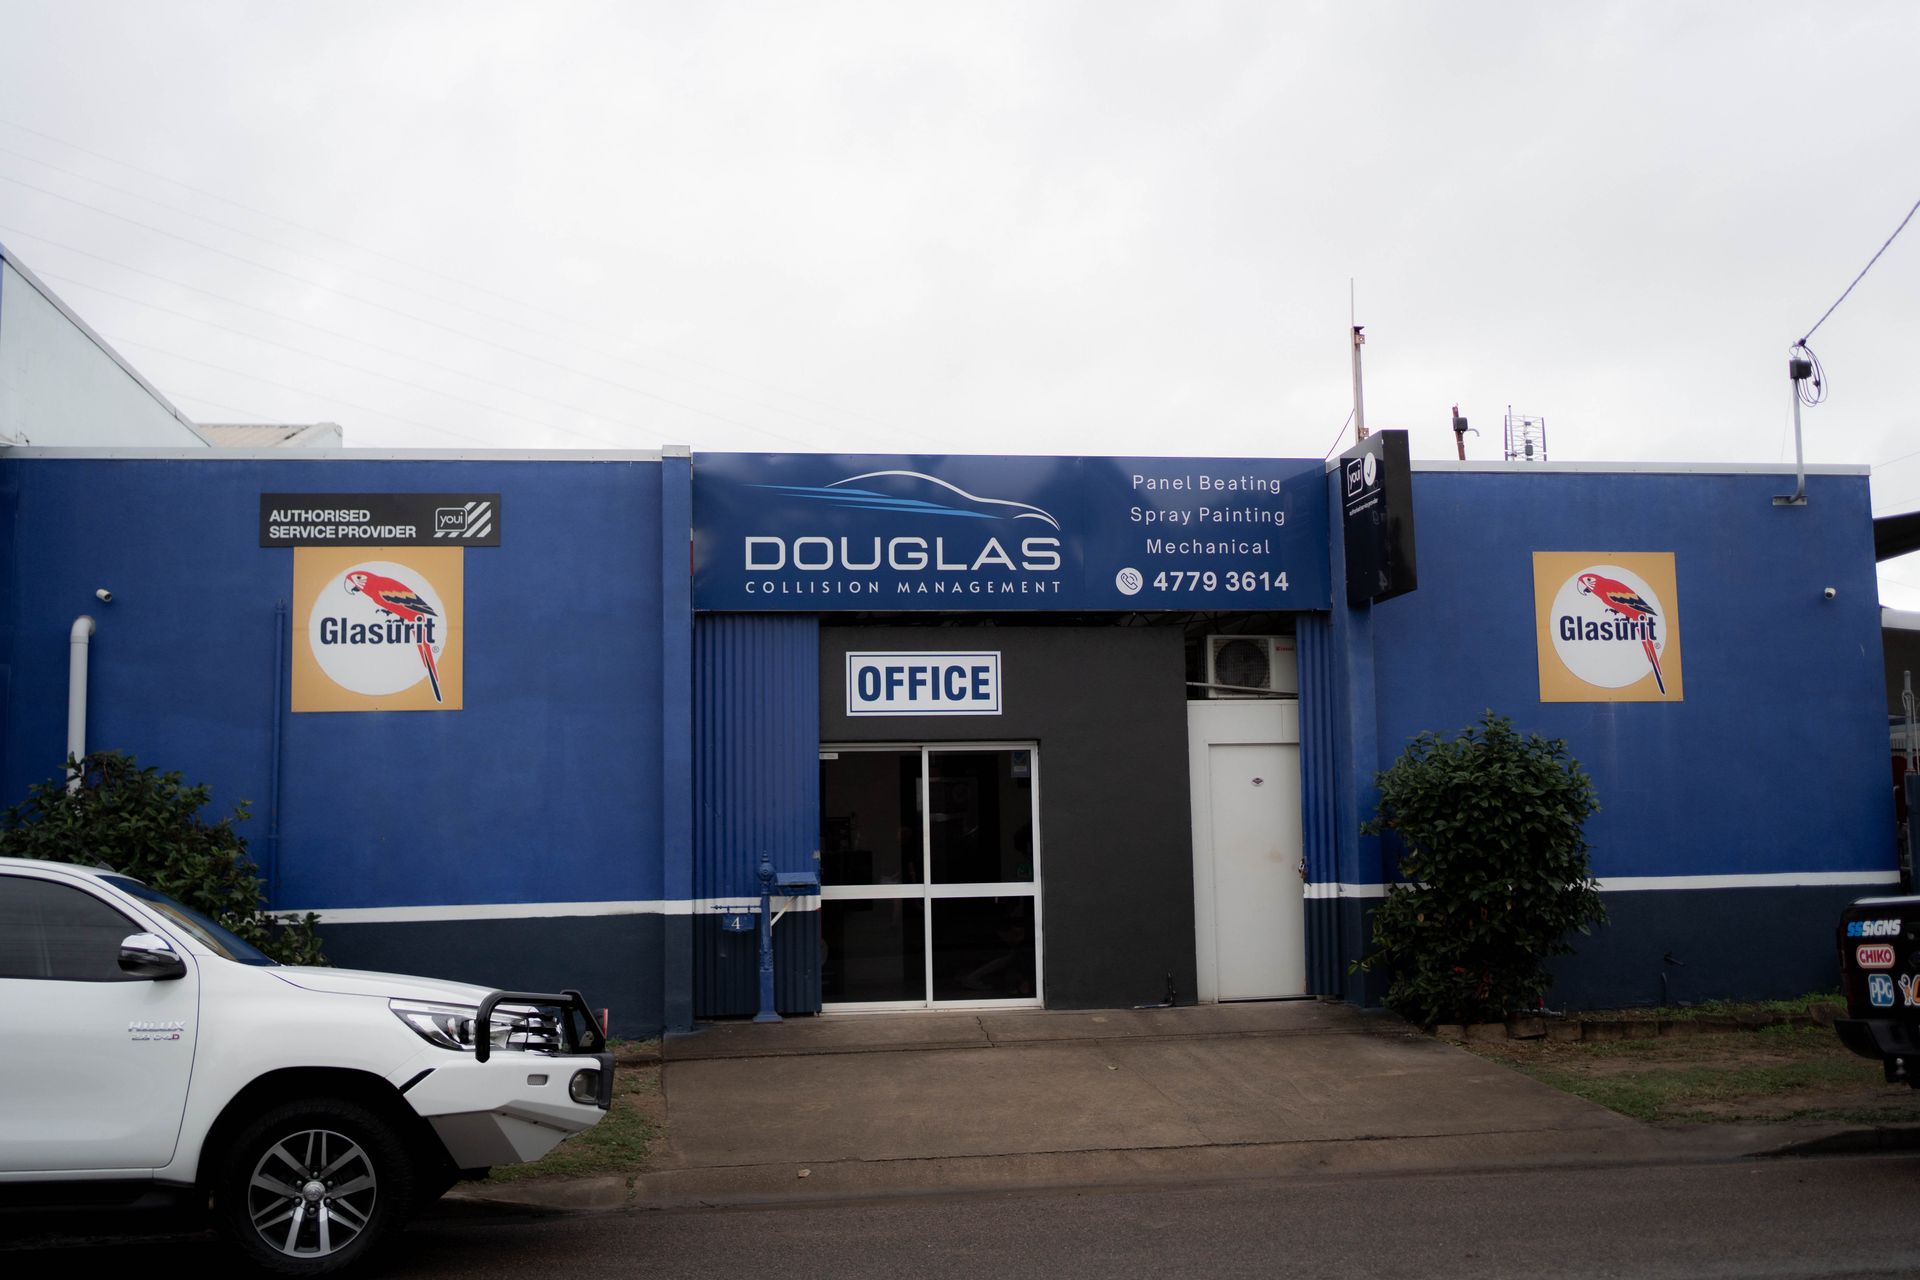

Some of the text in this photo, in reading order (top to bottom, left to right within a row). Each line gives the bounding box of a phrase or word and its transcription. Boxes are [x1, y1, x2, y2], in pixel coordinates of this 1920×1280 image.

[1133, 475, 1281, 494] Panel Beating
[269, 510, 370, 522] AUTHORISED
[440, 512, 463, 527] youi
[1130, 507, 1286, 526] Spray Painting
[269, 525, 416, 538] SERVICE PROVIDER
[745, 536, 1061, 571] DOUGLAS
[1146, 539, 1270, 554] Mechanical
[745, 581, 1061, 594] COLLISION MANAGEMENT
[1153, 571, 1289, 592] 4779 3614
[320, 615, 435, 645] Glasurit
[1560, 615, 1657, 641] Glasurit
[858, 665, 990, 701] OFFICE
[731, 916, 741, 930] 4
[1859, 949, 1893, 963] CHIKO
[1870, 977, 1892, 1003] PPG
